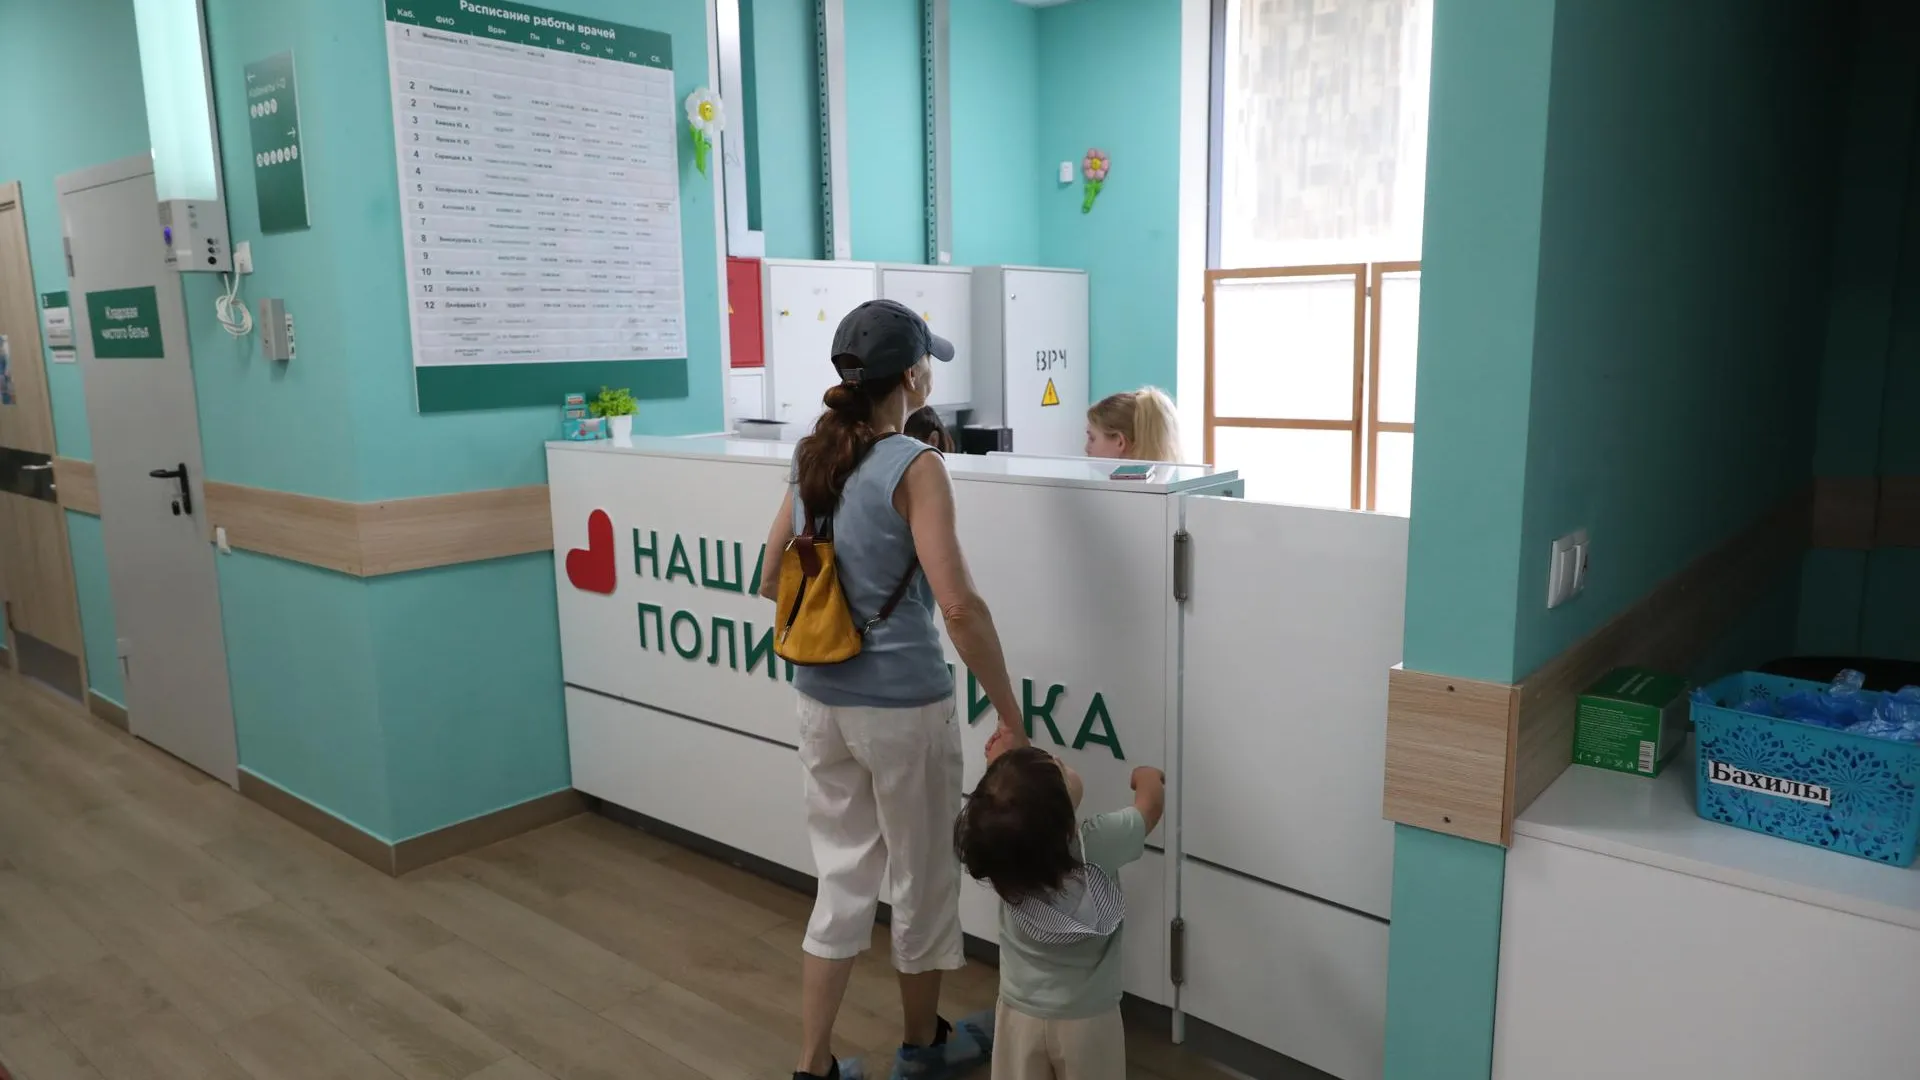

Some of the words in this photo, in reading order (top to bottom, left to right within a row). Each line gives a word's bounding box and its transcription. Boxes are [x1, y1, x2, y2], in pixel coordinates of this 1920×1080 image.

[460, 0, 530, 24] Расписание
[533, 16, 576, 31] работы
[577, 25, 616, 40] врачей
[397, 9, 415, 18] Каб.
[435, 16, 455, 26] ФИО
[487, 25, 507, 35] Врач
[530, 33, 540, 41] Пн
[556, 37, 565, 46] Вт
[580, 42, 590, 51] Ср
[405, 28, 411, 37] 1
[409, 81, 415, 90] 2
[411, 98, 417, 108] 2
[412, 115, 418, 125] 3
[413, 132, 420, 142] 3
[413, 150, 420, 159] 4
[415, 167, 422, 176] 4
[417, 183, 424, 193] 5
[418, 200, 425, 210] 6
[421, 217, 426, 226] 7
[421, 234, 427, 243] 8
[423, 252, 429, 260] 9
[421, 268, 432, 277] 10
[423, 284, 433, 293] 12
[424, 301, 435, 310] 12
[1711, 760, 1829, 802] Бахилы
